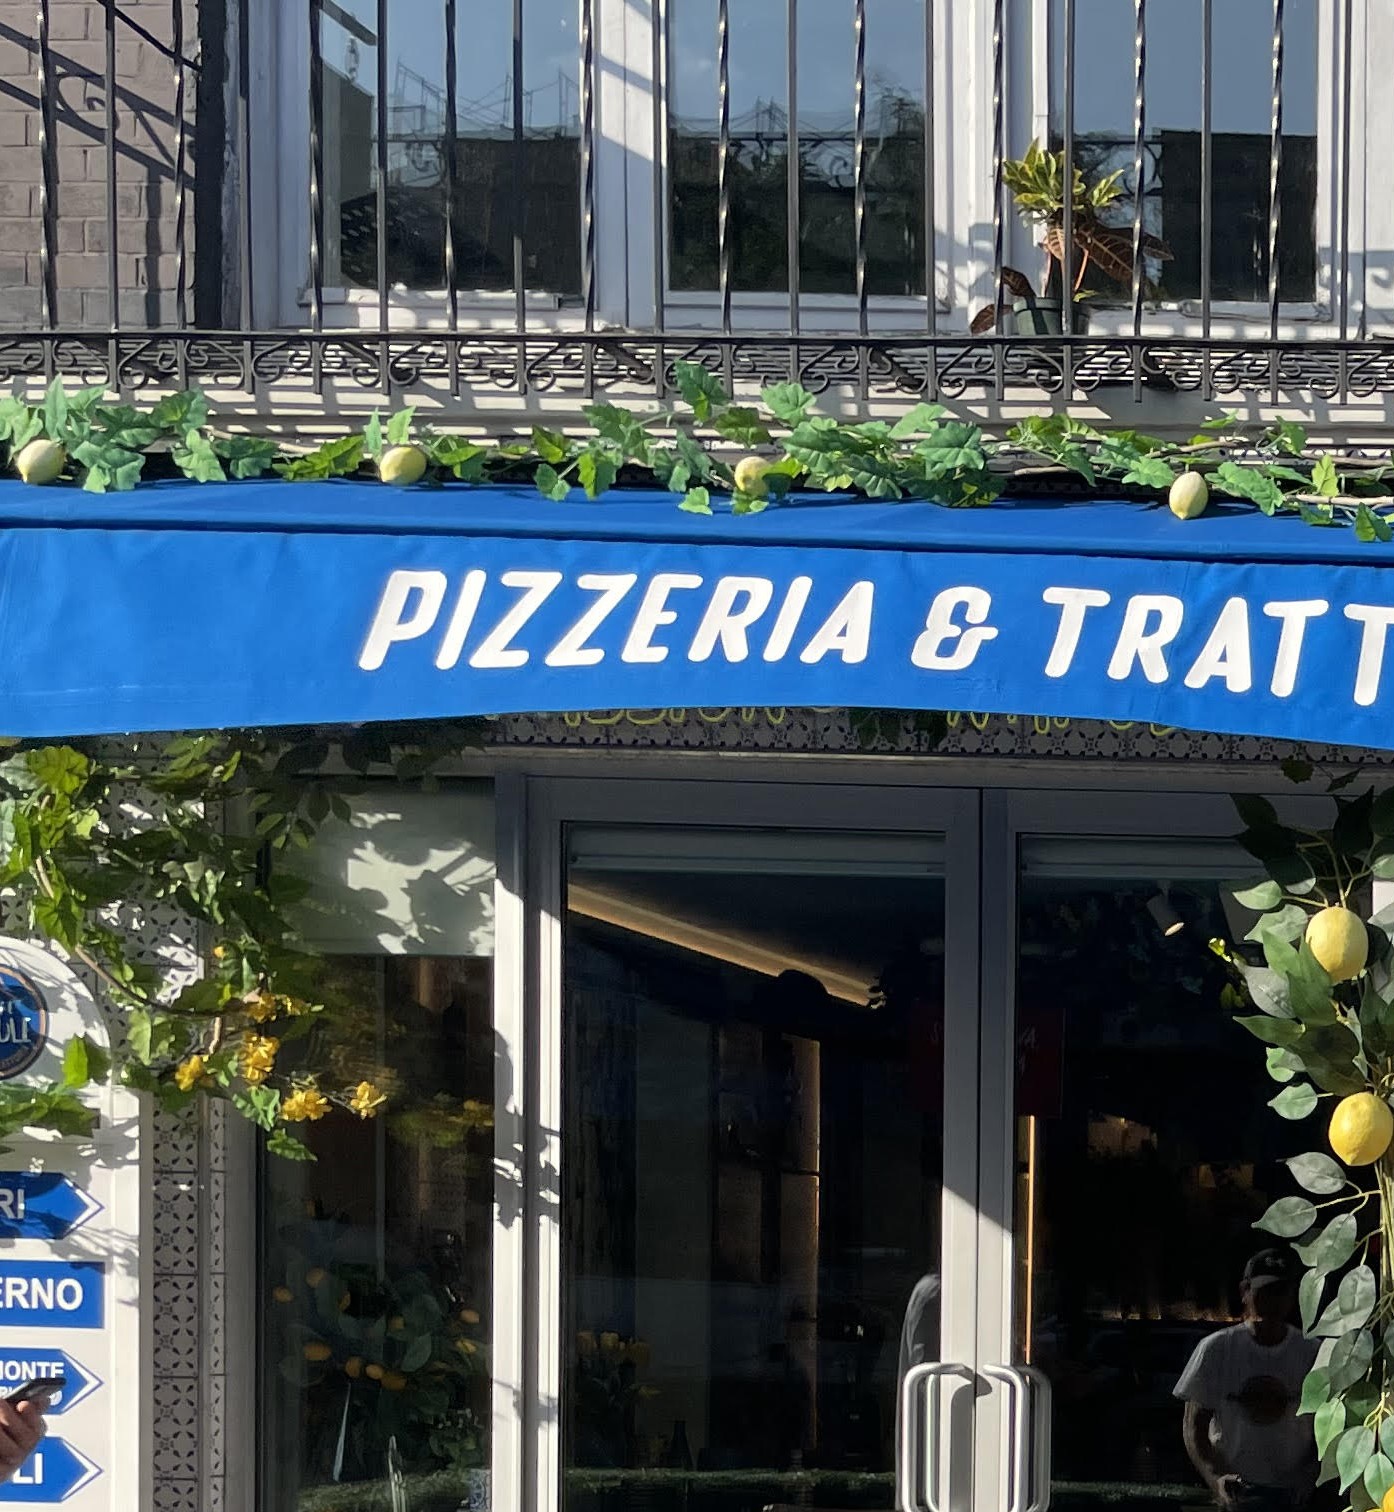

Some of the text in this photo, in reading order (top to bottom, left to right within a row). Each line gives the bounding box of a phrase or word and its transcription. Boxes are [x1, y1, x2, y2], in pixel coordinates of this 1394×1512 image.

[358, 569, 875, 671] PIZZERIA
[910, 585, 999, 671] &
[0, 1277, 84, 1311] RNO
